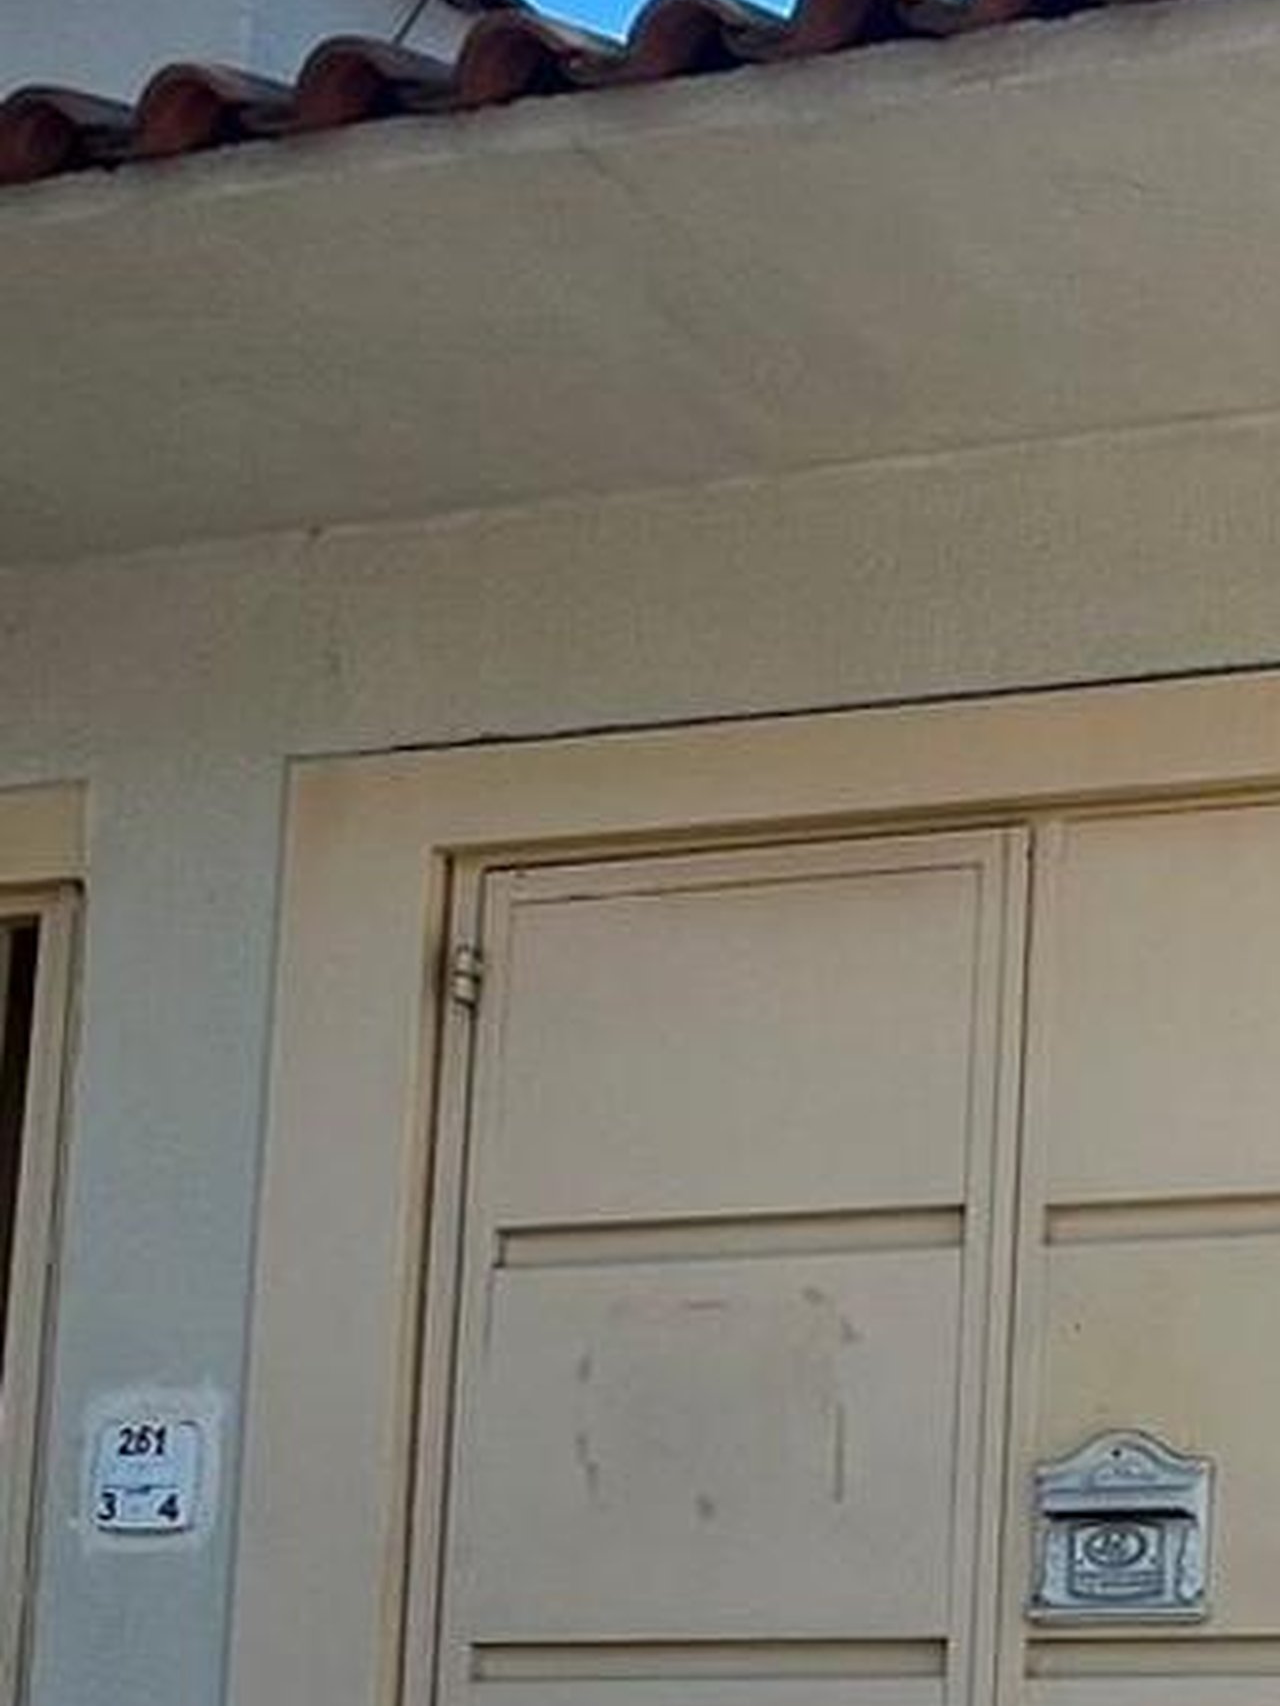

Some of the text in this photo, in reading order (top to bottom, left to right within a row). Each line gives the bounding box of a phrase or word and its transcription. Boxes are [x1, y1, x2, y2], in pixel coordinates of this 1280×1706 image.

[118, 1425, 168, 1457] 261
[97, 1492, 180, 1521] 3 4
